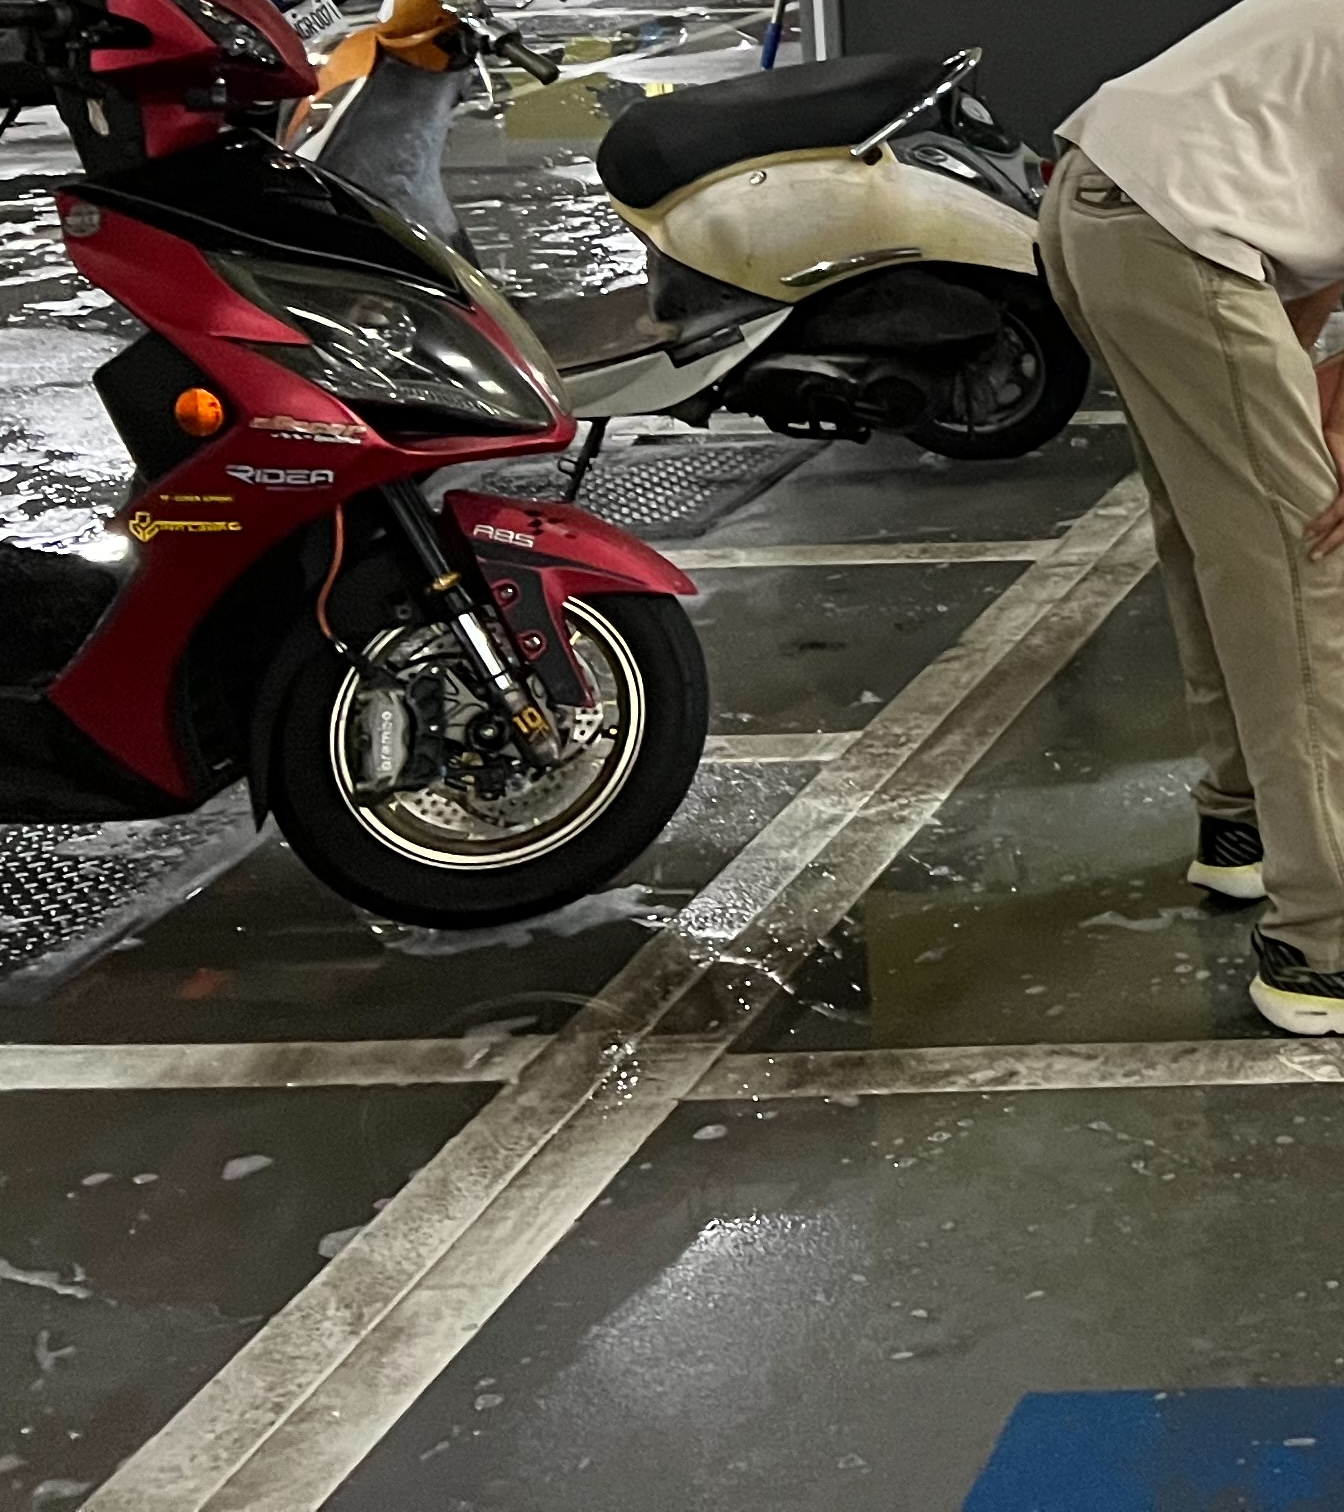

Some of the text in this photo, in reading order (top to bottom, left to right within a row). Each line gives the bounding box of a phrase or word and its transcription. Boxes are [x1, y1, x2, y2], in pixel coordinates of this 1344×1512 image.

[225, 464, 335, 485] RIDEA
[472, 524, 535, 548] ABS
[376, 710, 394, 772] brembo
